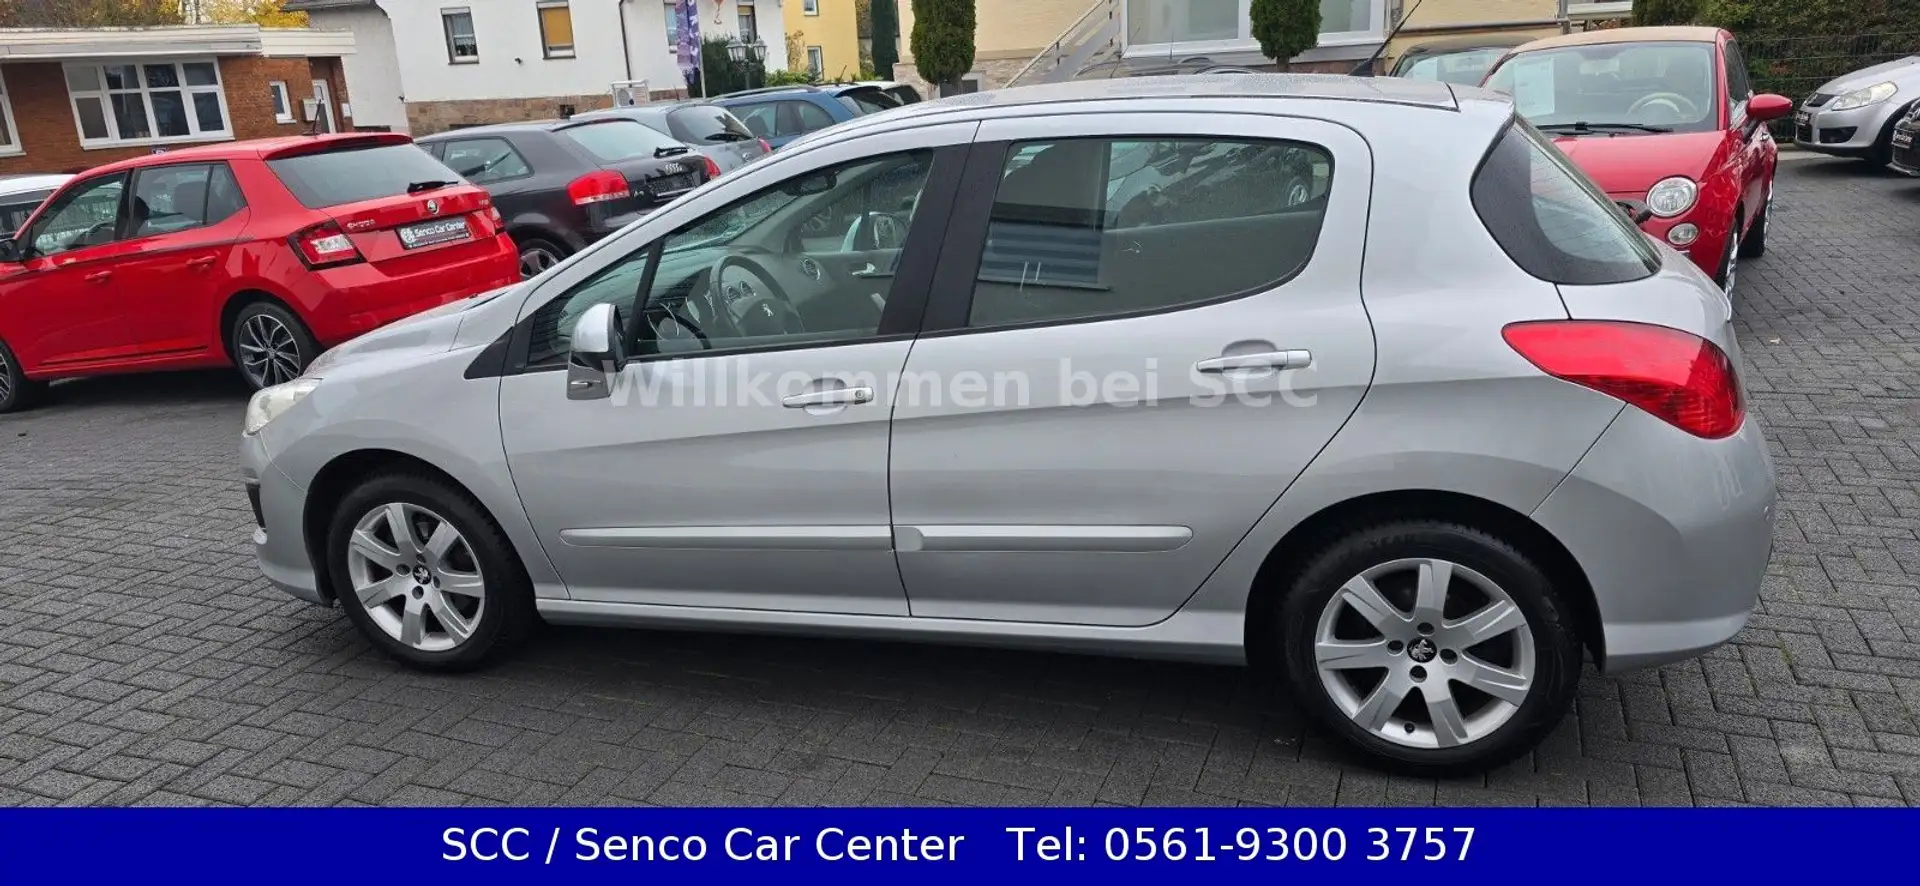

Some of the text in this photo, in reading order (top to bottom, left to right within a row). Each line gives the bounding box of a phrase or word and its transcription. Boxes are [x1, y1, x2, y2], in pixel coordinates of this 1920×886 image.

[414, 221, 465, 237] Senco Car Center
